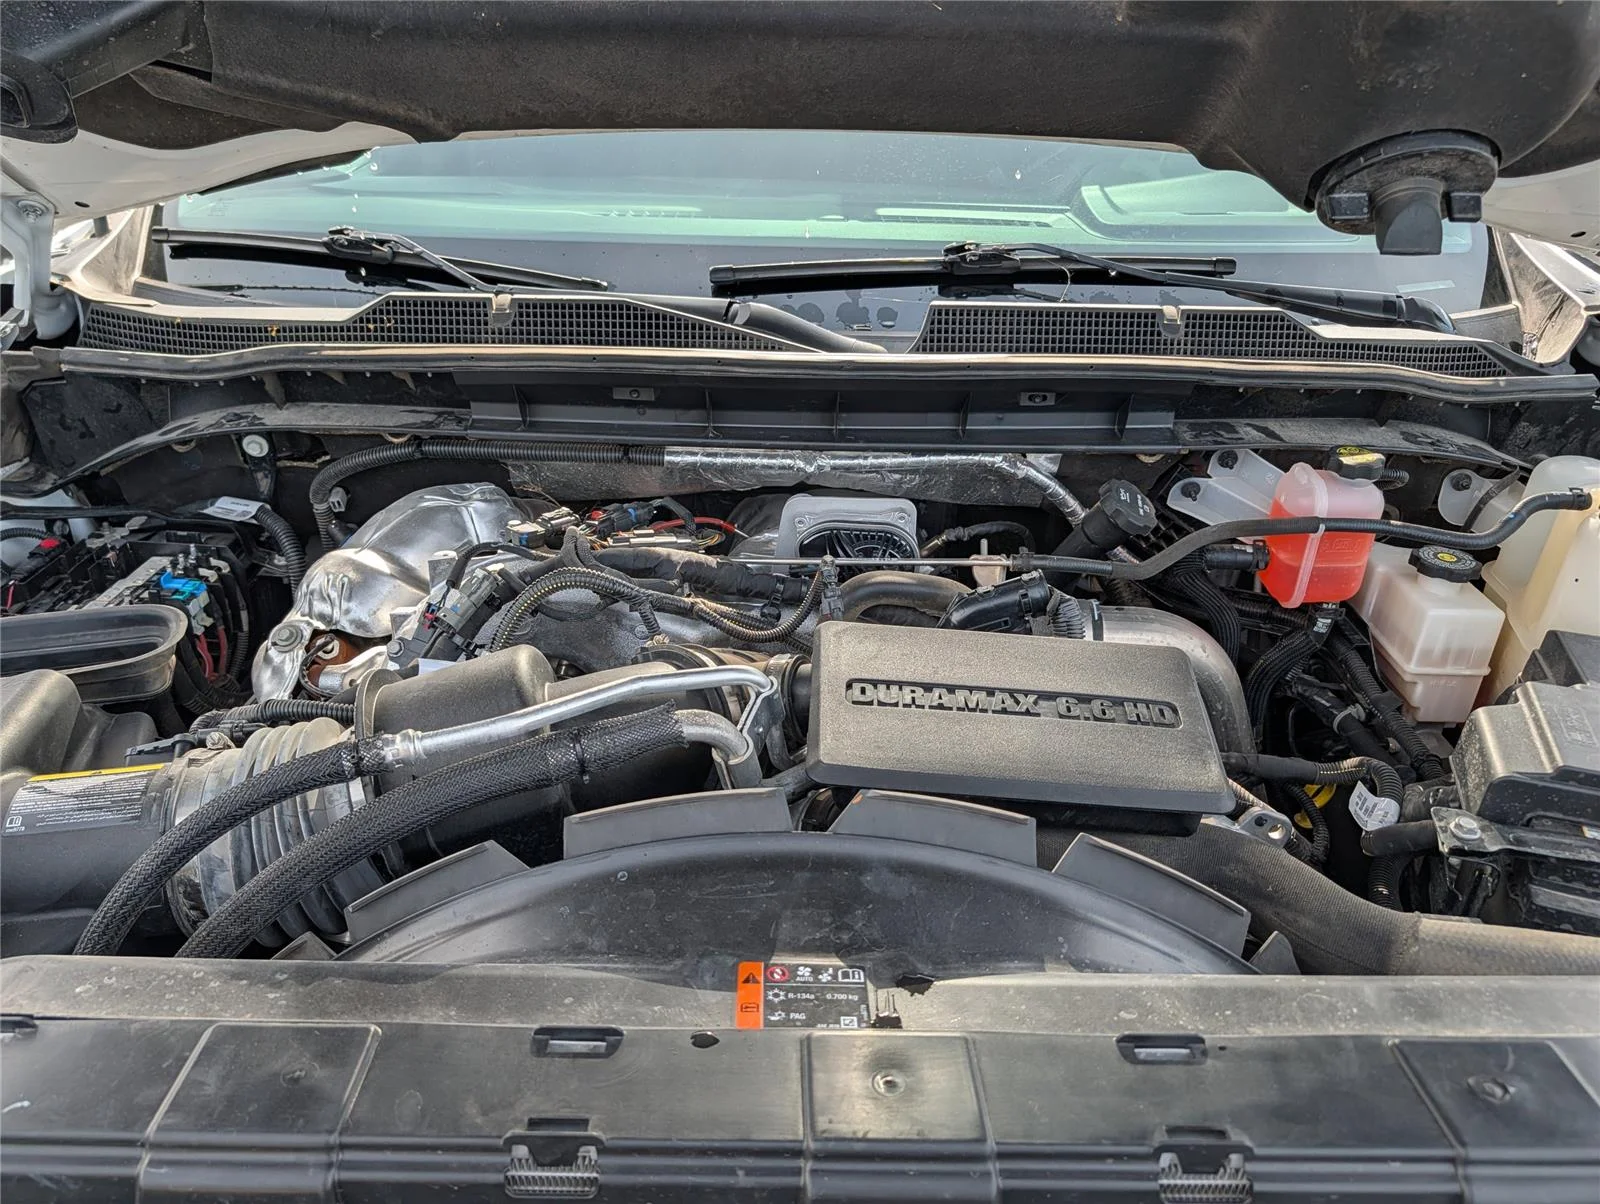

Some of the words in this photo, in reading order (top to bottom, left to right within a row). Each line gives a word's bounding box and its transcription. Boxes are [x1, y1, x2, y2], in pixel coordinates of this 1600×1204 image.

[850, 682, 1040, 715] DURAMAX
[1055, 696, 1116, 721] 6.6
[1124, 701, 1177, 726] HD
[788, 992, 815, 1000] R-134a
[790, 1012, 806, 1020] PAG
